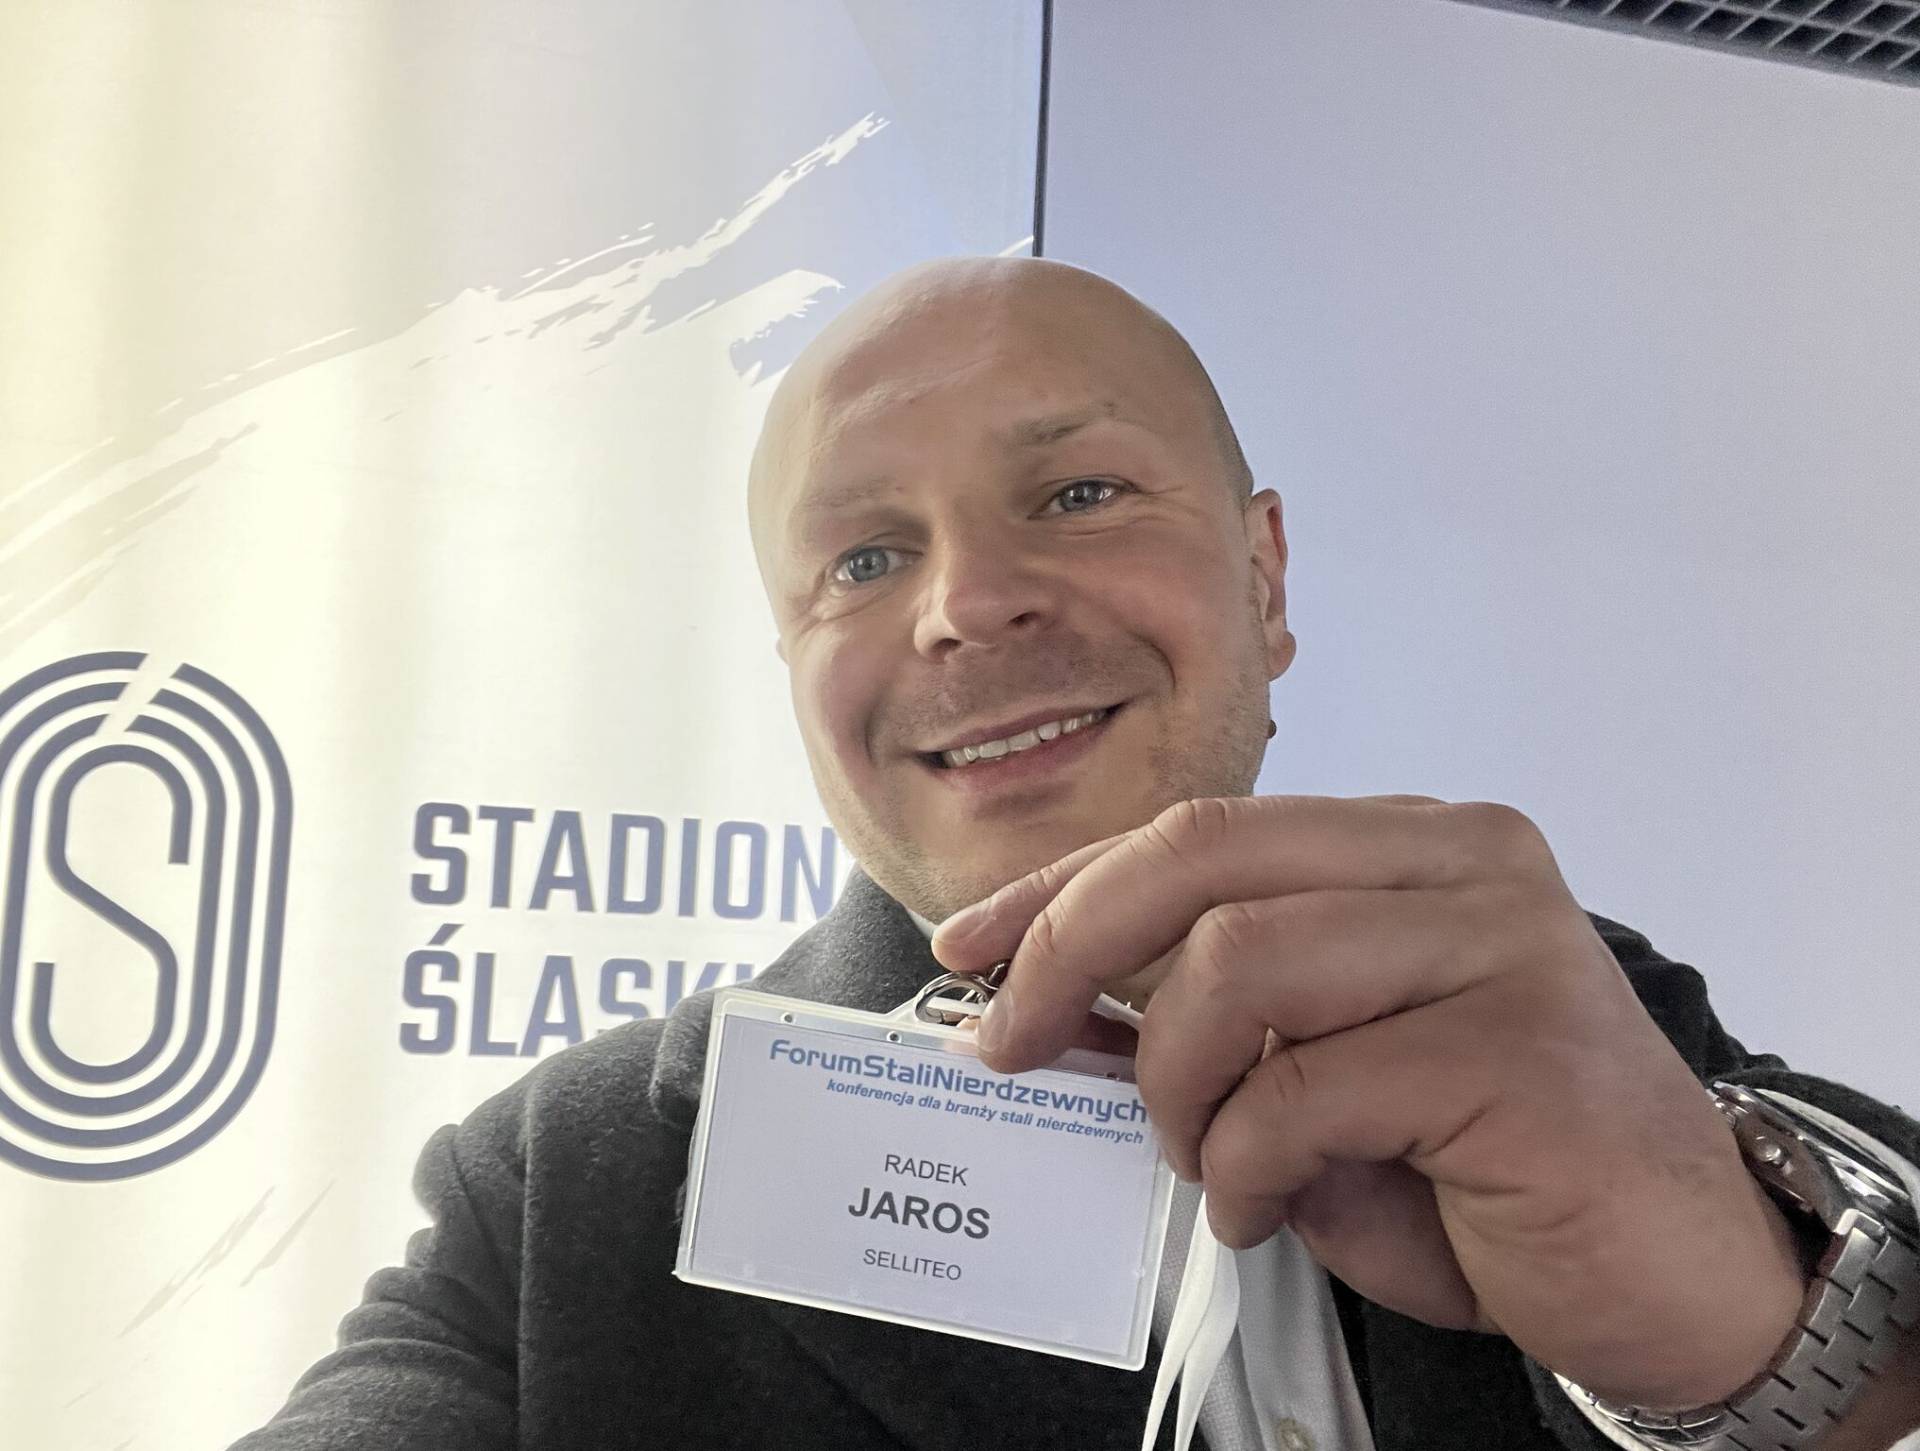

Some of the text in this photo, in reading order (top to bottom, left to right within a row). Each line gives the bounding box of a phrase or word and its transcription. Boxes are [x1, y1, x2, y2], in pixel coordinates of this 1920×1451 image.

[410, 801, 836, 923] STADION
[769, 1039, 1147, 1124] ForumStaliNierdzewnych
[826, 1078, 1144, 1145] konferencja dla branży stali nierdzewnych
[884, 1153, 969, 1187] RADEK
[848, 1187, 991, 1240] JAROS
[862, 1248, 963, 1282] SELLITEO
